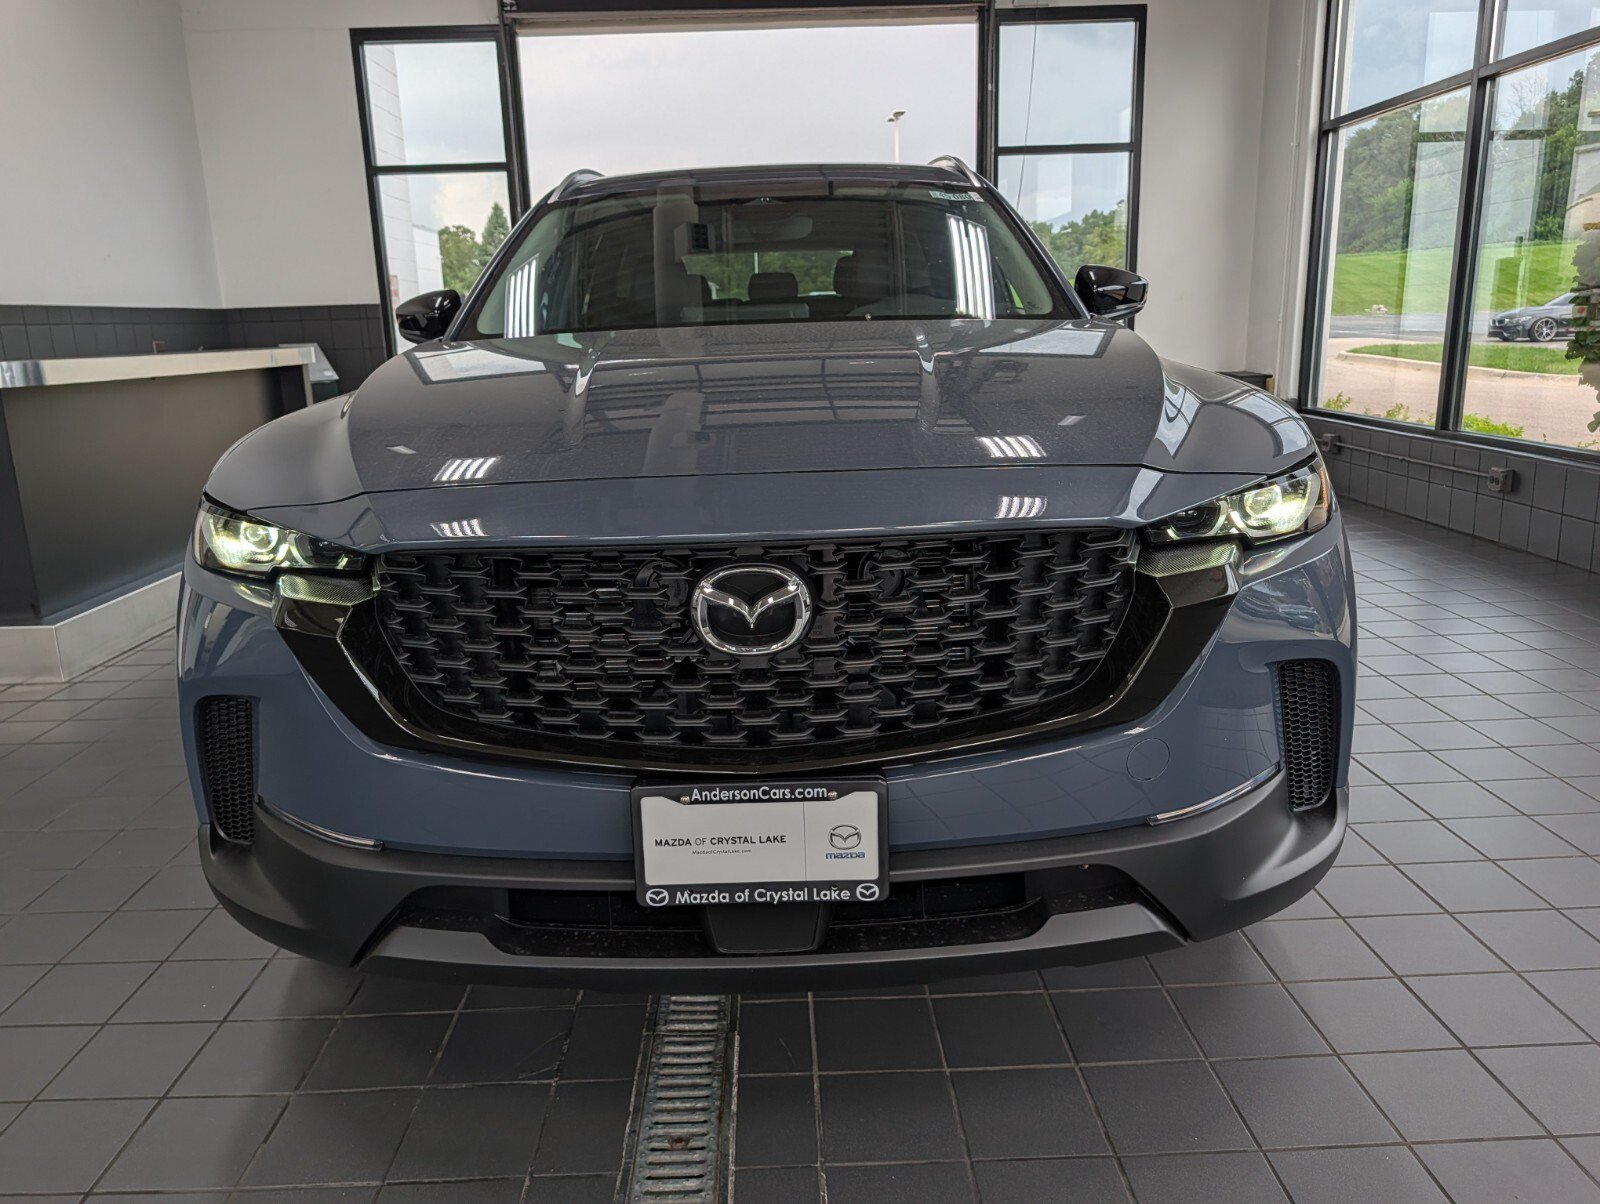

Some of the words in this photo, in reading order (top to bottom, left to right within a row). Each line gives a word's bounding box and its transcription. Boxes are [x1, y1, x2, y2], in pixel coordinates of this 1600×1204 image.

[691, 786, 828, 802] AndersonCars.com
[654, 838, 692, 847] MAZDA
[694, 837, 708, 847] OF
[710, 836, 757, 846] CRYSTAL
[759, 834, 787, 844] LAKE
[825, 851, 866, 860] mazda
[675, 890, 730, 905] Mazda
[734, 888, 750, 903] of
[754, 887, 808, 905] Crystal
[813, 886, 851, 901] Lake
